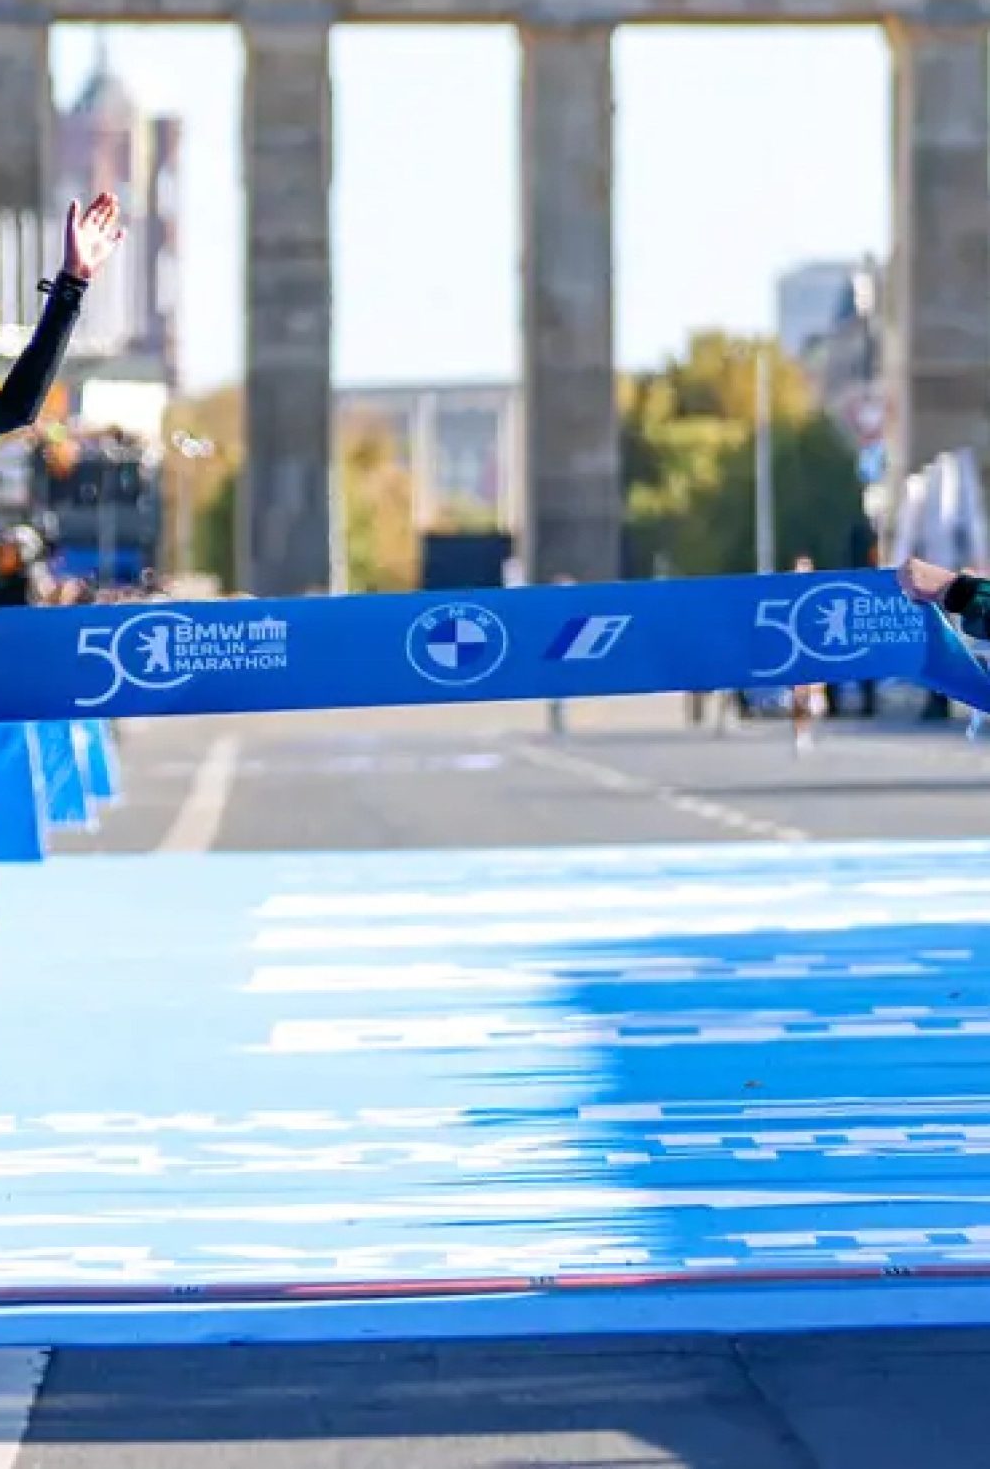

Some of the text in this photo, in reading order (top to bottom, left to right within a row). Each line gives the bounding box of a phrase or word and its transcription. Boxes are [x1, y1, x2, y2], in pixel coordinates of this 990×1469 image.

[175, 623, 245, 642] BMW
[175, 641, 246, 656] BERLIN
[175, 655, 288, 672] MARATHON
